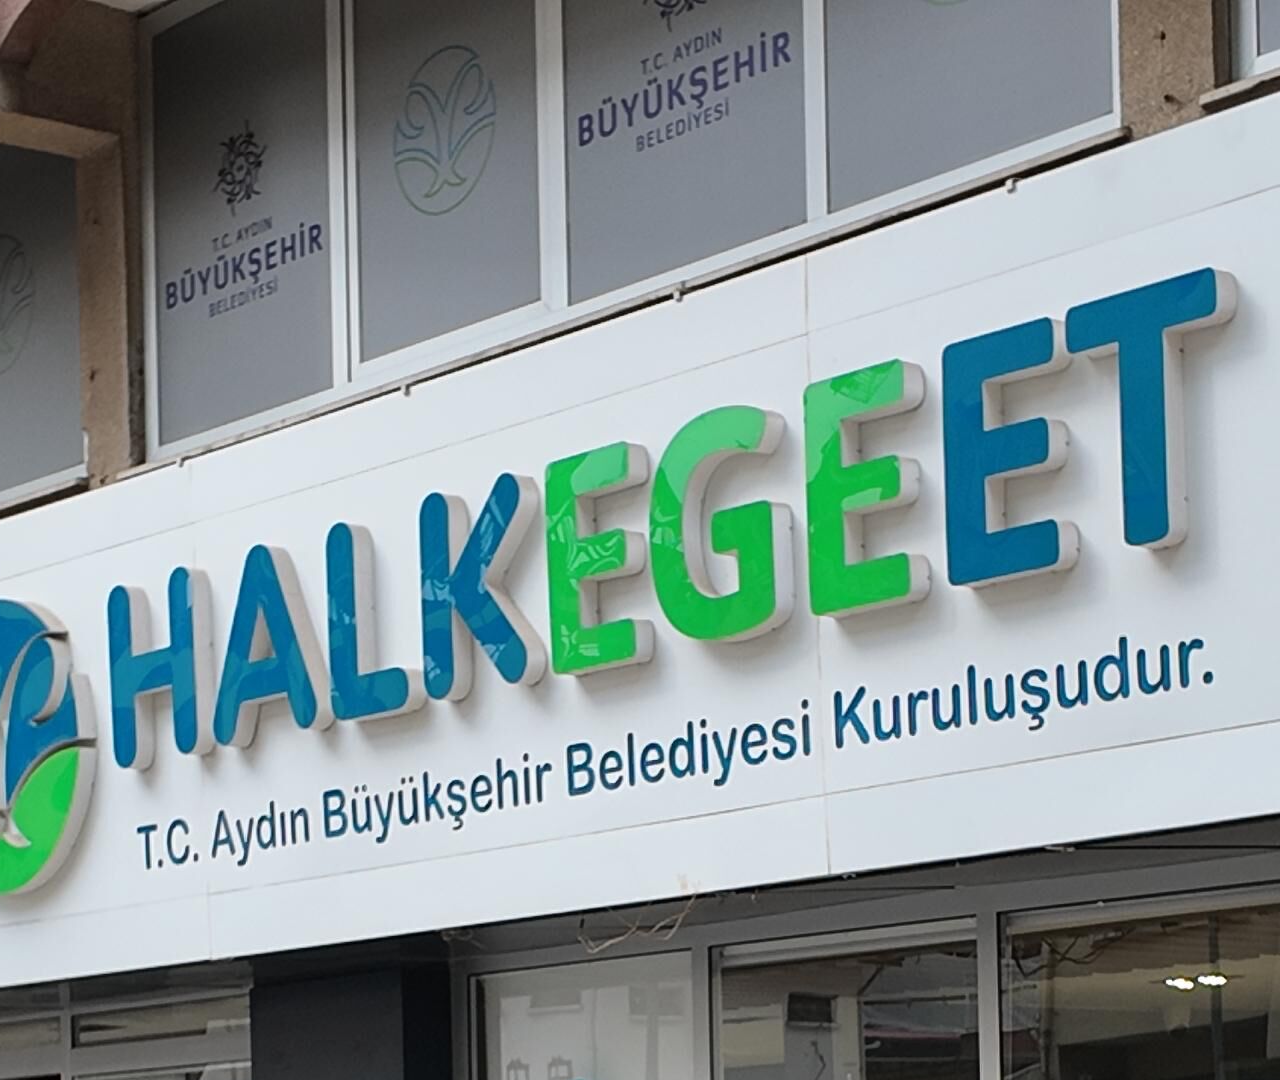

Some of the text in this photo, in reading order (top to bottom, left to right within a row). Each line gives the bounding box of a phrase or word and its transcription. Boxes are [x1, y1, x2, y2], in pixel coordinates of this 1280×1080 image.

[577, 31, 792, 147] BÜYÜKŞEHİR
[640, 27, 723, 75] T.C. AYDIN
[635, 97, 730, 152] BELEDİYESİ
[165, 221, 324, 310] BÜYÜKŞEHİR
[107, 267, 1230, 770] HALKEGEET
[136, 635, 1216, 871] T.C. Aydın Büyükşehir Belediyesi Kuruluşudur.
